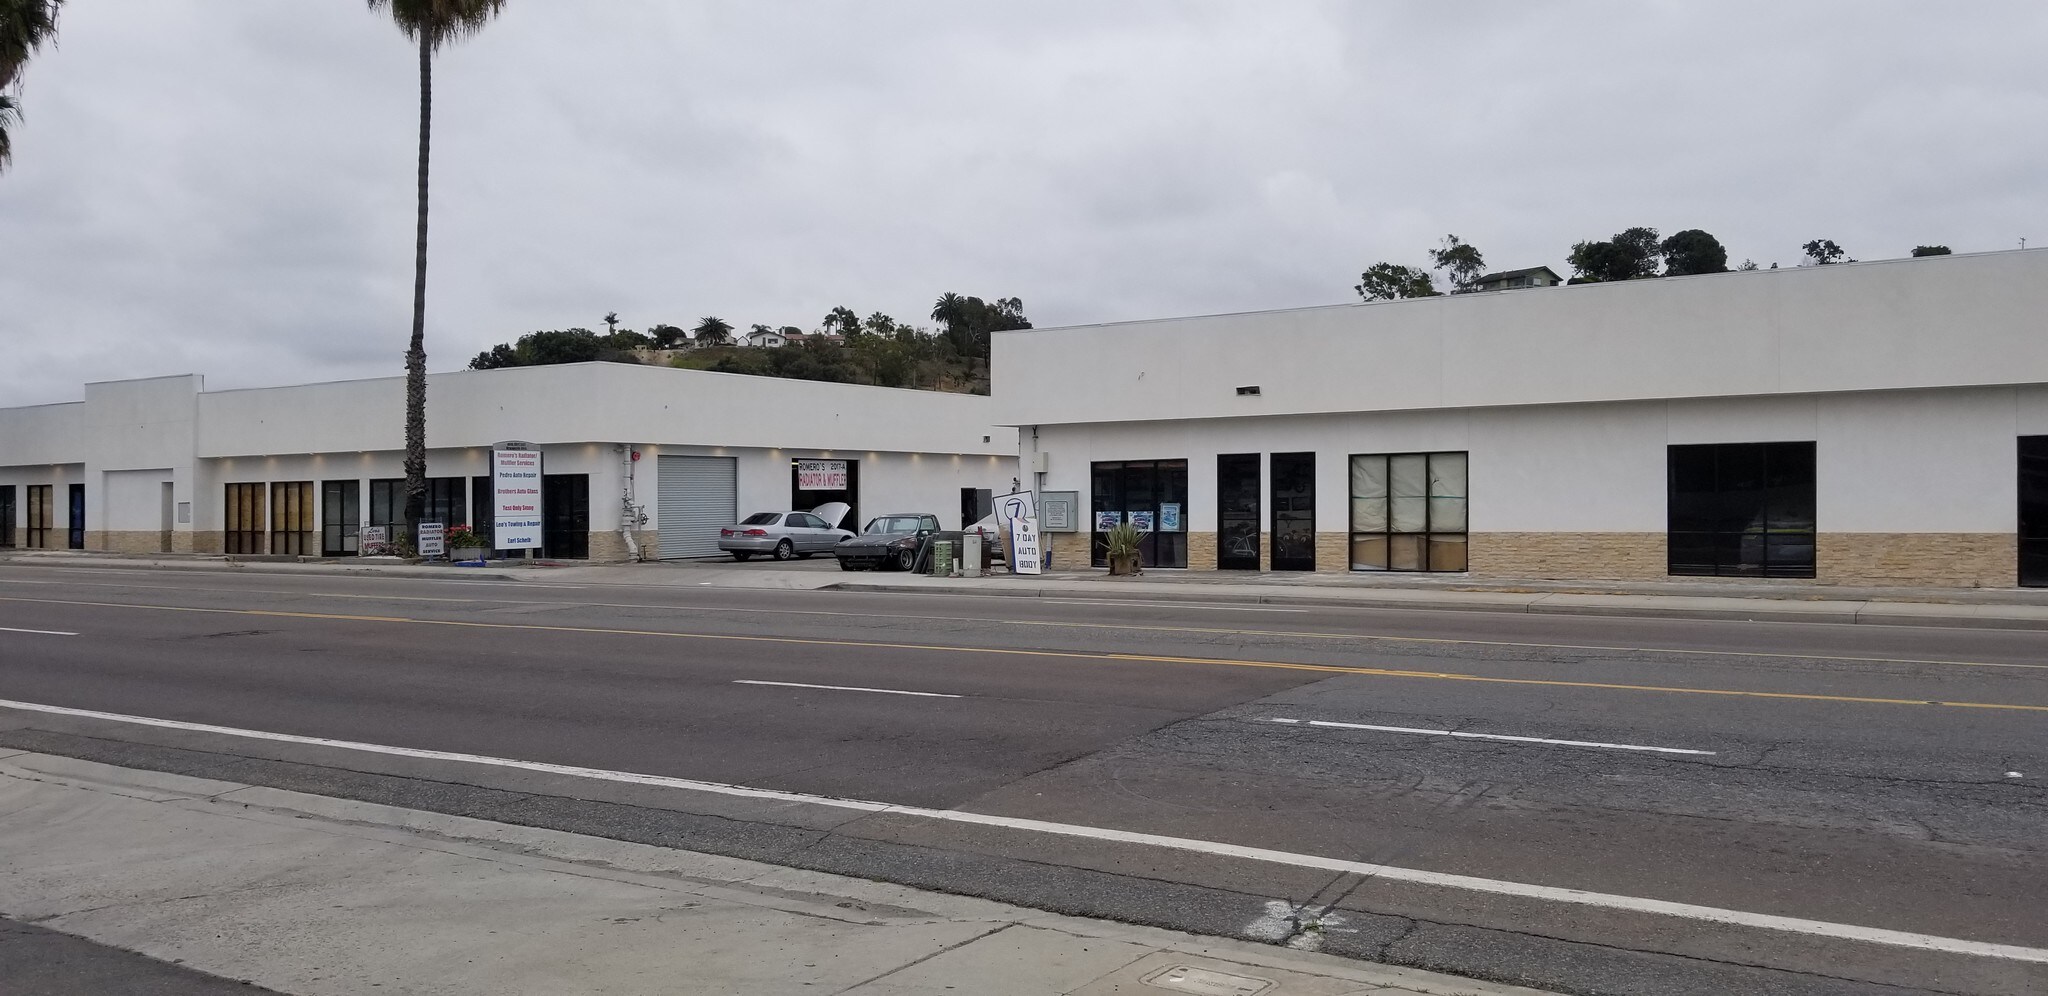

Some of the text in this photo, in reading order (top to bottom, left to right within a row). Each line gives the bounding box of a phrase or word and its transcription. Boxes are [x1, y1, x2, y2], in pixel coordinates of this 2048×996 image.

[799, 462, 826, 471] ROMERO'S
[800, 473, 822, 486] RADIATOR
[1007, 502, 1020, 518] 7
[1022, 534, 1036, 542] DAY
[1018, 547, 1036, 556] AUTO
[1019, 560, 1037, 568] BODY
